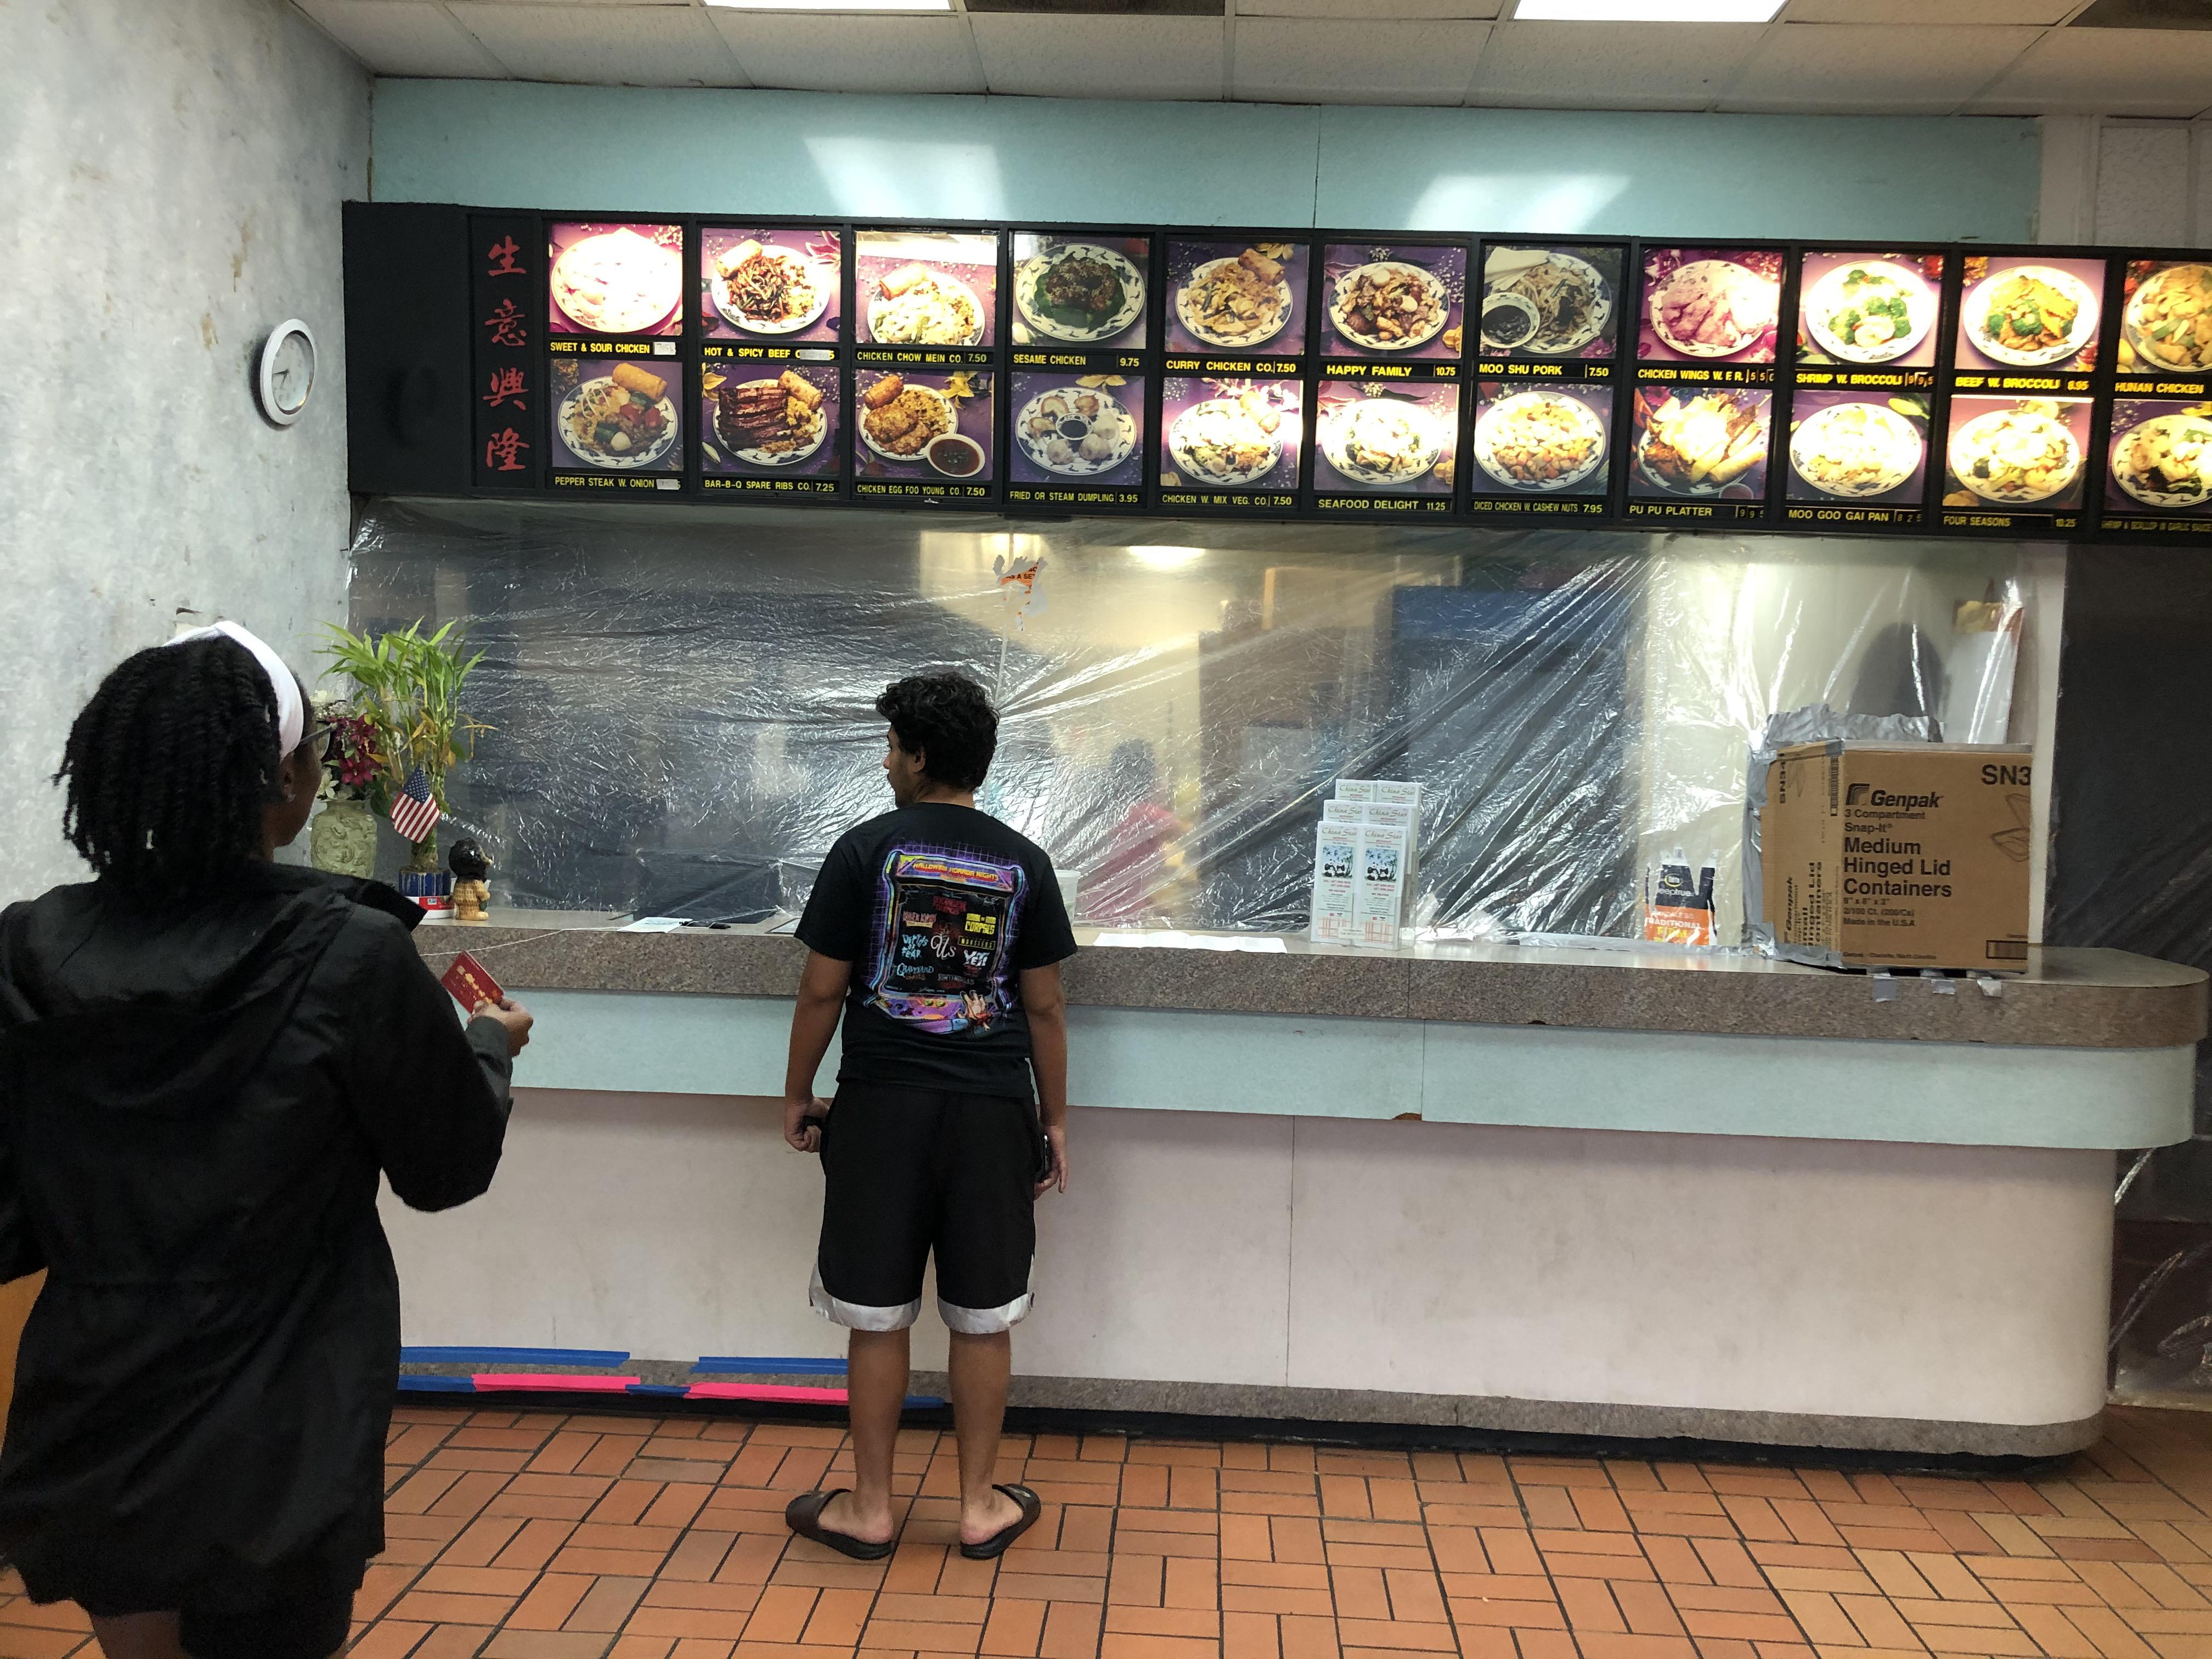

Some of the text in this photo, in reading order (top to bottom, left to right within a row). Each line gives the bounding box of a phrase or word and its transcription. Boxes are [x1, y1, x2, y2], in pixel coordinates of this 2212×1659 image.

[550, 342, 578, 352] SWEET
[581, 343, 587, 352] &
[590, 343, 612, 353] SOUR
[616, 343, 650, 354] CHICKEN
[704, 347, 723, 357] HOT
[727, 348, 733, 357] &
[738, 348, 764, 358] SPICY
[768, 349, 791, 358] BEEF
[857, 352, 987, 363] CHICKEN CHOW MEIN CO. 7.50
[1014, 354, 1139, 366] SESAME CHICKEN 9.75
[1166, 360, 1200, 370] CURRY
[1206, 362, 1251, 371] CHICKEN
[1277, 364, 1296, 373] 7.50
[1327, 364, 1456, 376] HAPPY FAMILY 10.75
[1479, 363, 1609, 377] MOO SHU PORK 7.50
[1638, 369, 1677, 379] CHICKEN
[1680, 370, 1710, 380] WINGS
[1796, 374, 1833, 383] SHRIMP
[1955, 377, 1985, 387] BEEF
[2156, 383, 2204, 394] CHICKEN
[555, 476, 585, 486] PEPPER
[588, 478, 614, 487] STEAK
[618, 478, 627, 488] W.
[630, 478, 654, 488] ONION
[705, 479, 834, 492] BAR-B-Q SPARE RIBS CO. 7.25
[857, 484, 885, 493] CHICKEN
[889, 486, 902, 494] EGG
[905, 486, 919, 494] FOO
[922, 486, 945, 495] YOUNG
[966, 487, 985, 496] 7.50
[1010, 491, 1138, 503] FRIED OR STEAM DUMPLING 3.95
[1162, 494, 1197, 504] CHICKEN
[1213, 496, 1227, 505] MIX
[1232, 496, 1250, 505] VEG.
[1273, 496, 1292, 505] 7.50
[1318, 499, 1446, 511] SEAFOOD DELIGHT 11.25
[1474, 501, 1493, 510] DICED
[1494, 501, 1522, 511] CHICKEN
[1533, 503, 1560, 512] CASHEW
[1561, 503, 1578, 512] NUTS
[1583, 504, 1602, 513] 7.95
[1629, 505, 1643, 514] PU
[1647, 505, 1662, 515] PU
[1666, 506, 1712, 516] PLATTER
[1788, 510, 1813, 519] MOO
[1817, 510, 1841, 520] GOO
[1846, 511, 1865, 521] GAI
[1867, 512, 1889, 522] PAN
[1943, 516, 1966, 526] FOUR
[1970, 517, 2012, 527] SEASONS
[1871, 789, 1942, 812] Genpak
[1328, 805, 1346, 814] China
[1369, 808, 1389, 816] China
[1845, 809, 1926, 820] 3 Compartment
[1322, 827, 1341, 835] China
[1364, 830, 1385, 838] China
[1844, 837, 1921, 855] Medium
[1844, 857, 1951, 878] Hinged Lid
[1843, 878, 1952, 897] Containers
